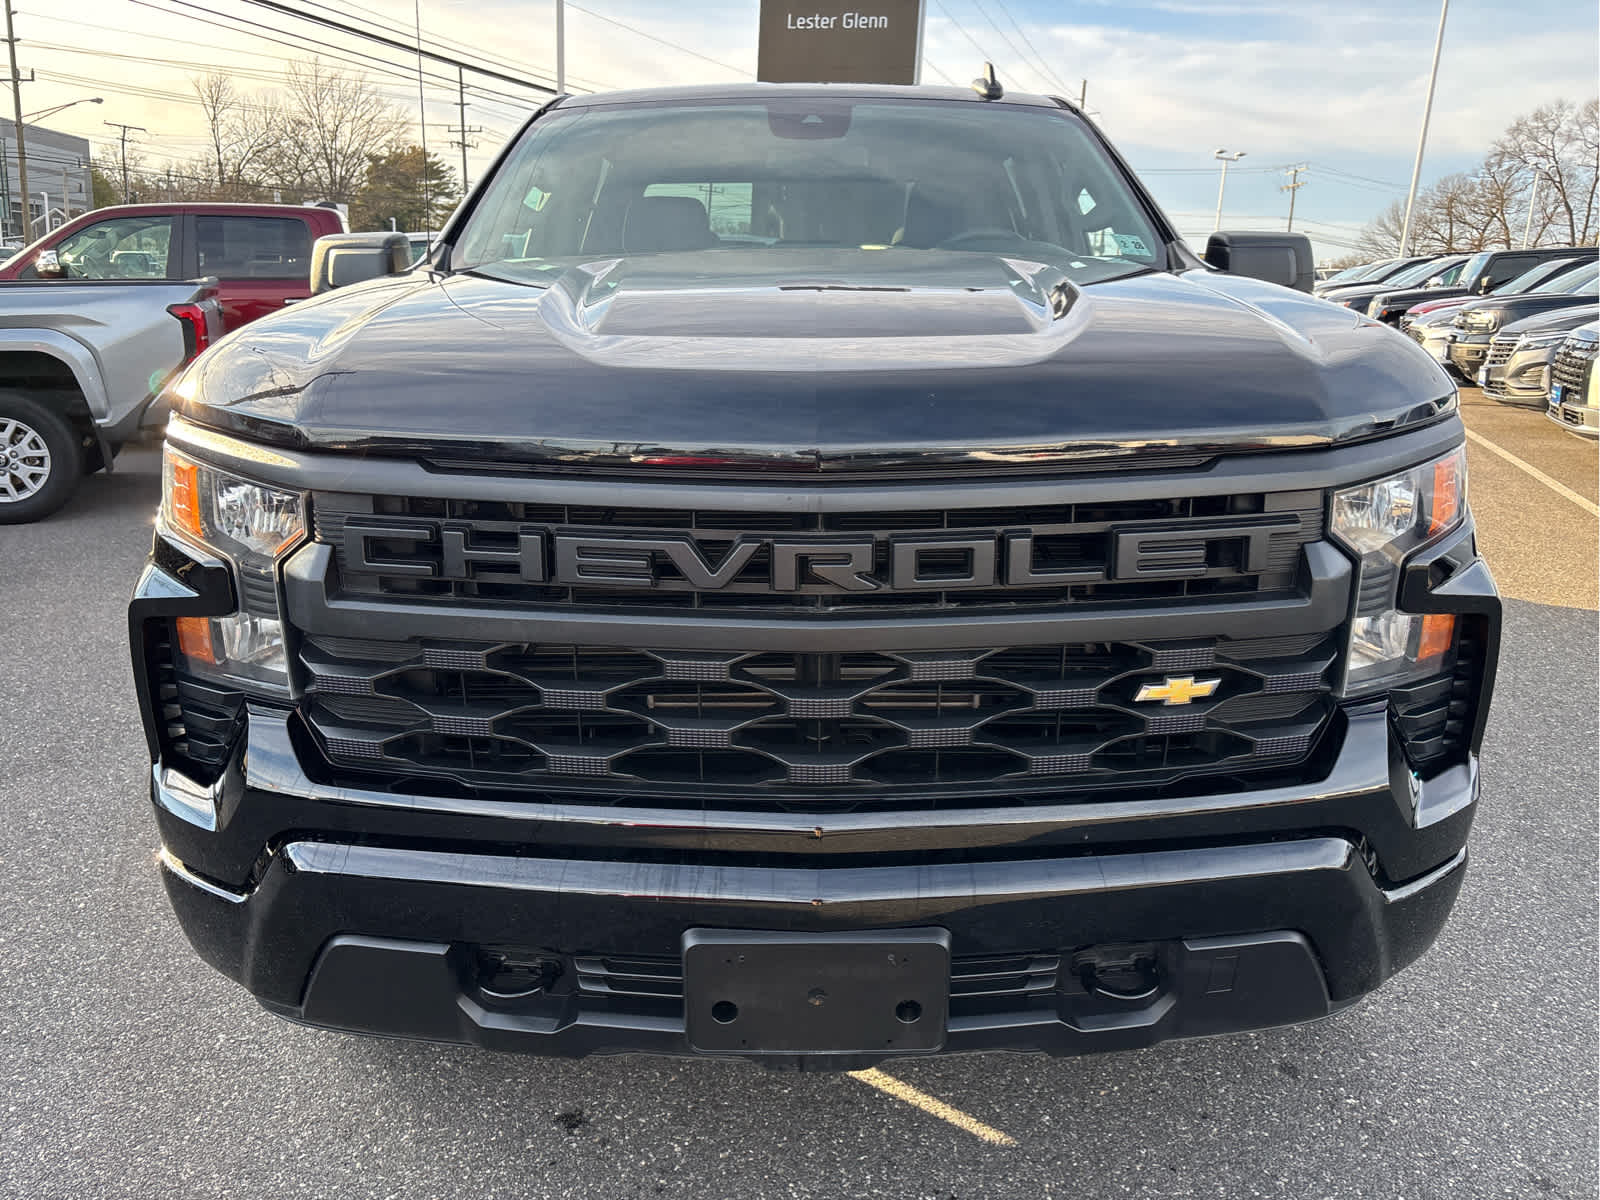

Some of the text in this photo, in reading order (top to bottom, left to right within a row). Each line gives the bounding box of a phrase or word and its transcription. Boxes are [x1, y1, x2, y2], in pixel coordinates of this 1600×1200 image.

[787, 12, 888, 30] Lester Glenn
[343, 515, 1300, 593] CHEVROLET
